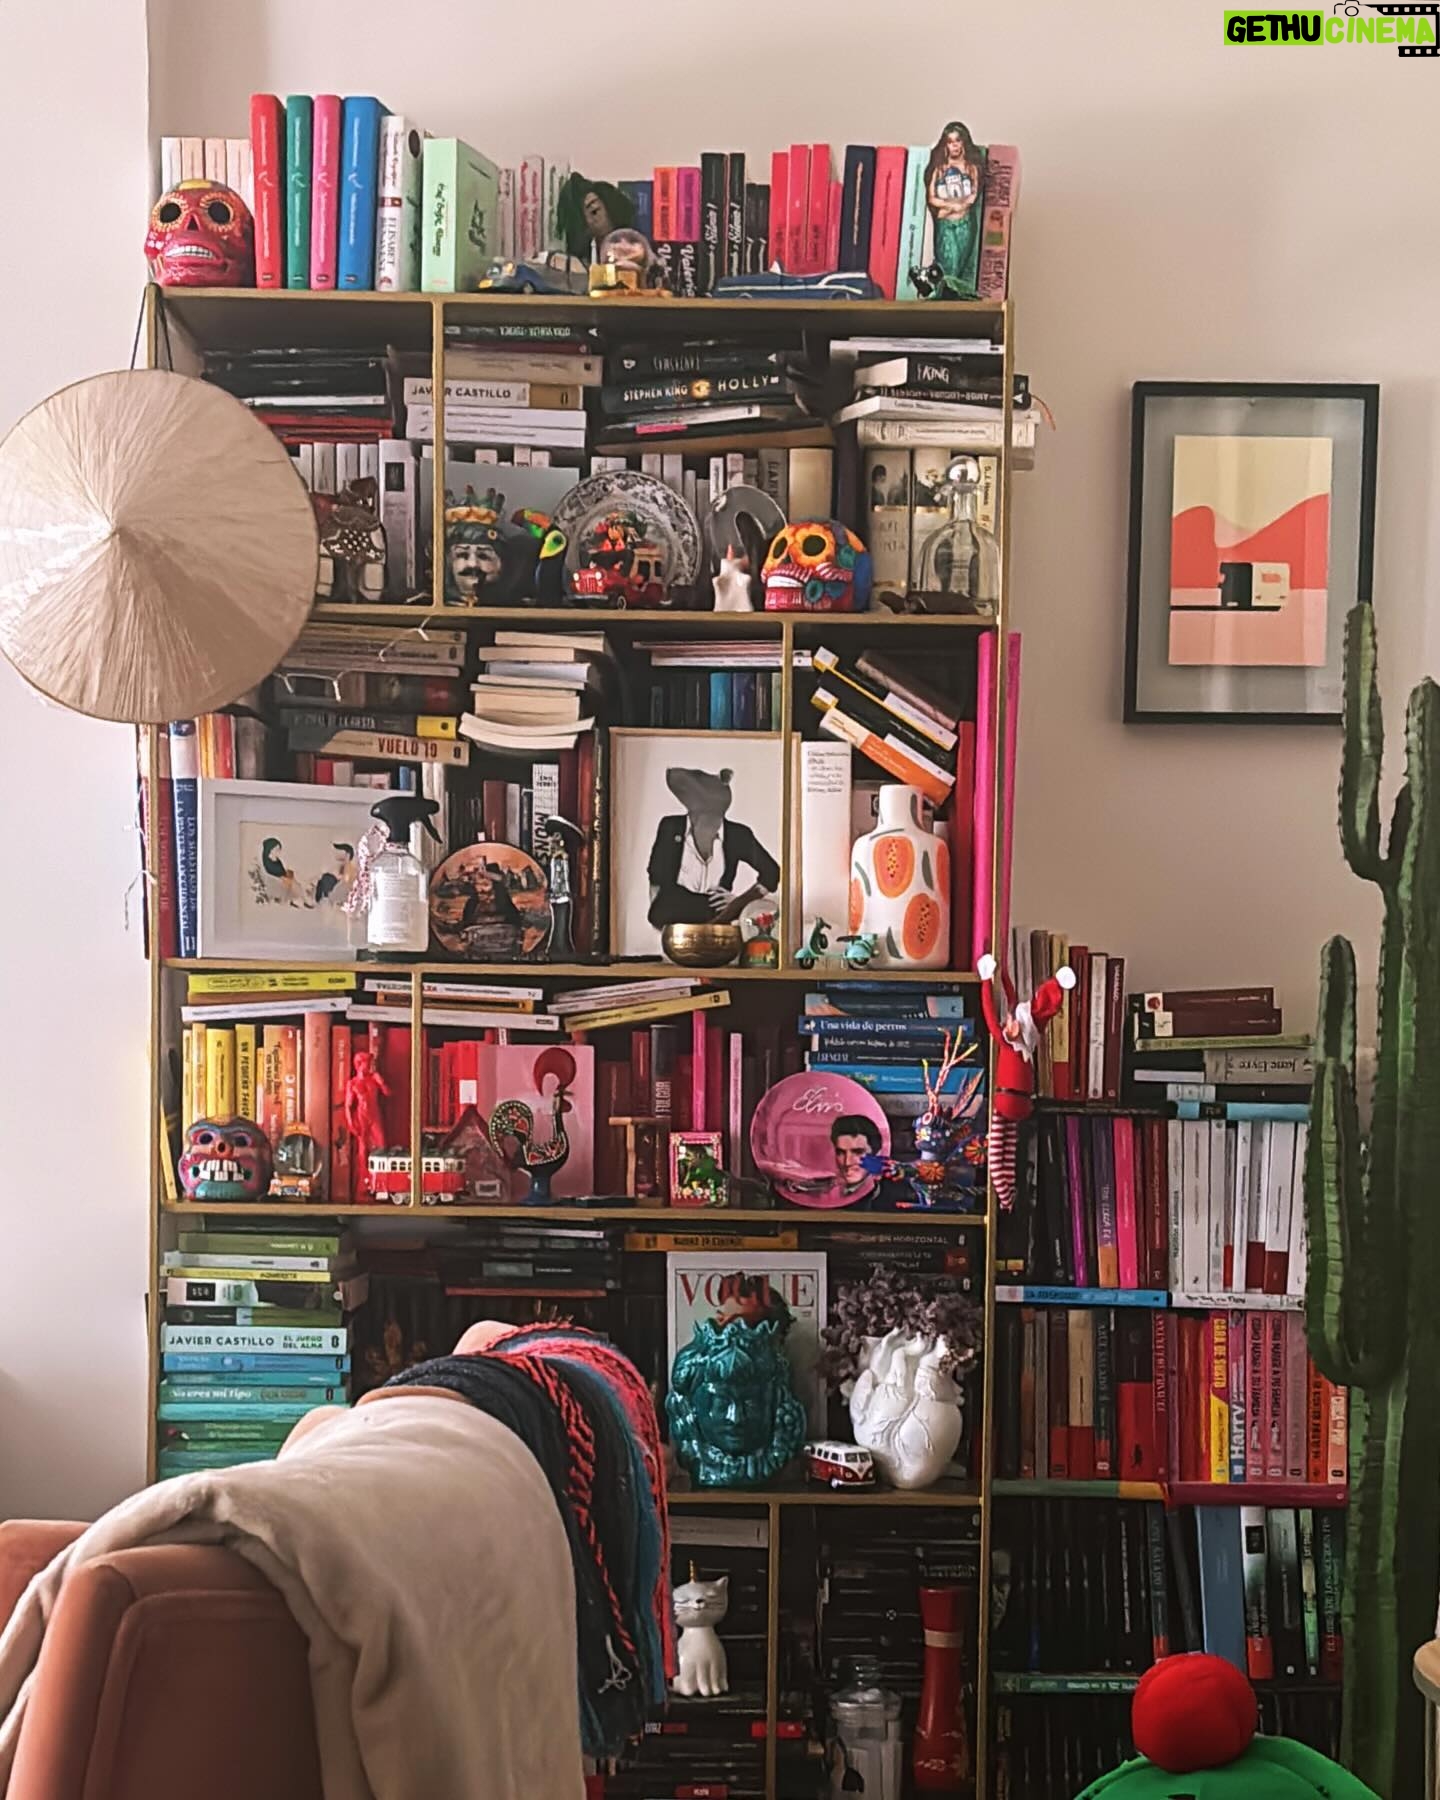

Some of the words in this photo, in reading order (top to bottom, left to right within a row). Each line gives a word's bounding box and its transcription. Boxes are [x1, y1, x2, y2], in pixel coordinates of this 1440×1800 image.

[411, 385, 452, 398] JAVR
[455, 386, 512, 399] CASTILLO
[623, 388, 663, 402] STEPHEN
[664, 384, 689, 398] KING
[717, 375, 769, 392] HOLLY
[377, 737, 419, 755] VUELO
[820, 1020, 837, 1031] Una
[838, 1020, 860, 1030] vida
[861, 1020, 874, 1031] de
[875, 1022, 907, 1033] perros
[792, 1086, 845, 1113] Elvis
[893, 1234, 949, 1245] HORIZONTAL
[169, 1335, 212, 1346] JAVIER
[216, 1335, 275, 1346] CASTILLO
[1231, 1403, 1245, 1459] Harry
